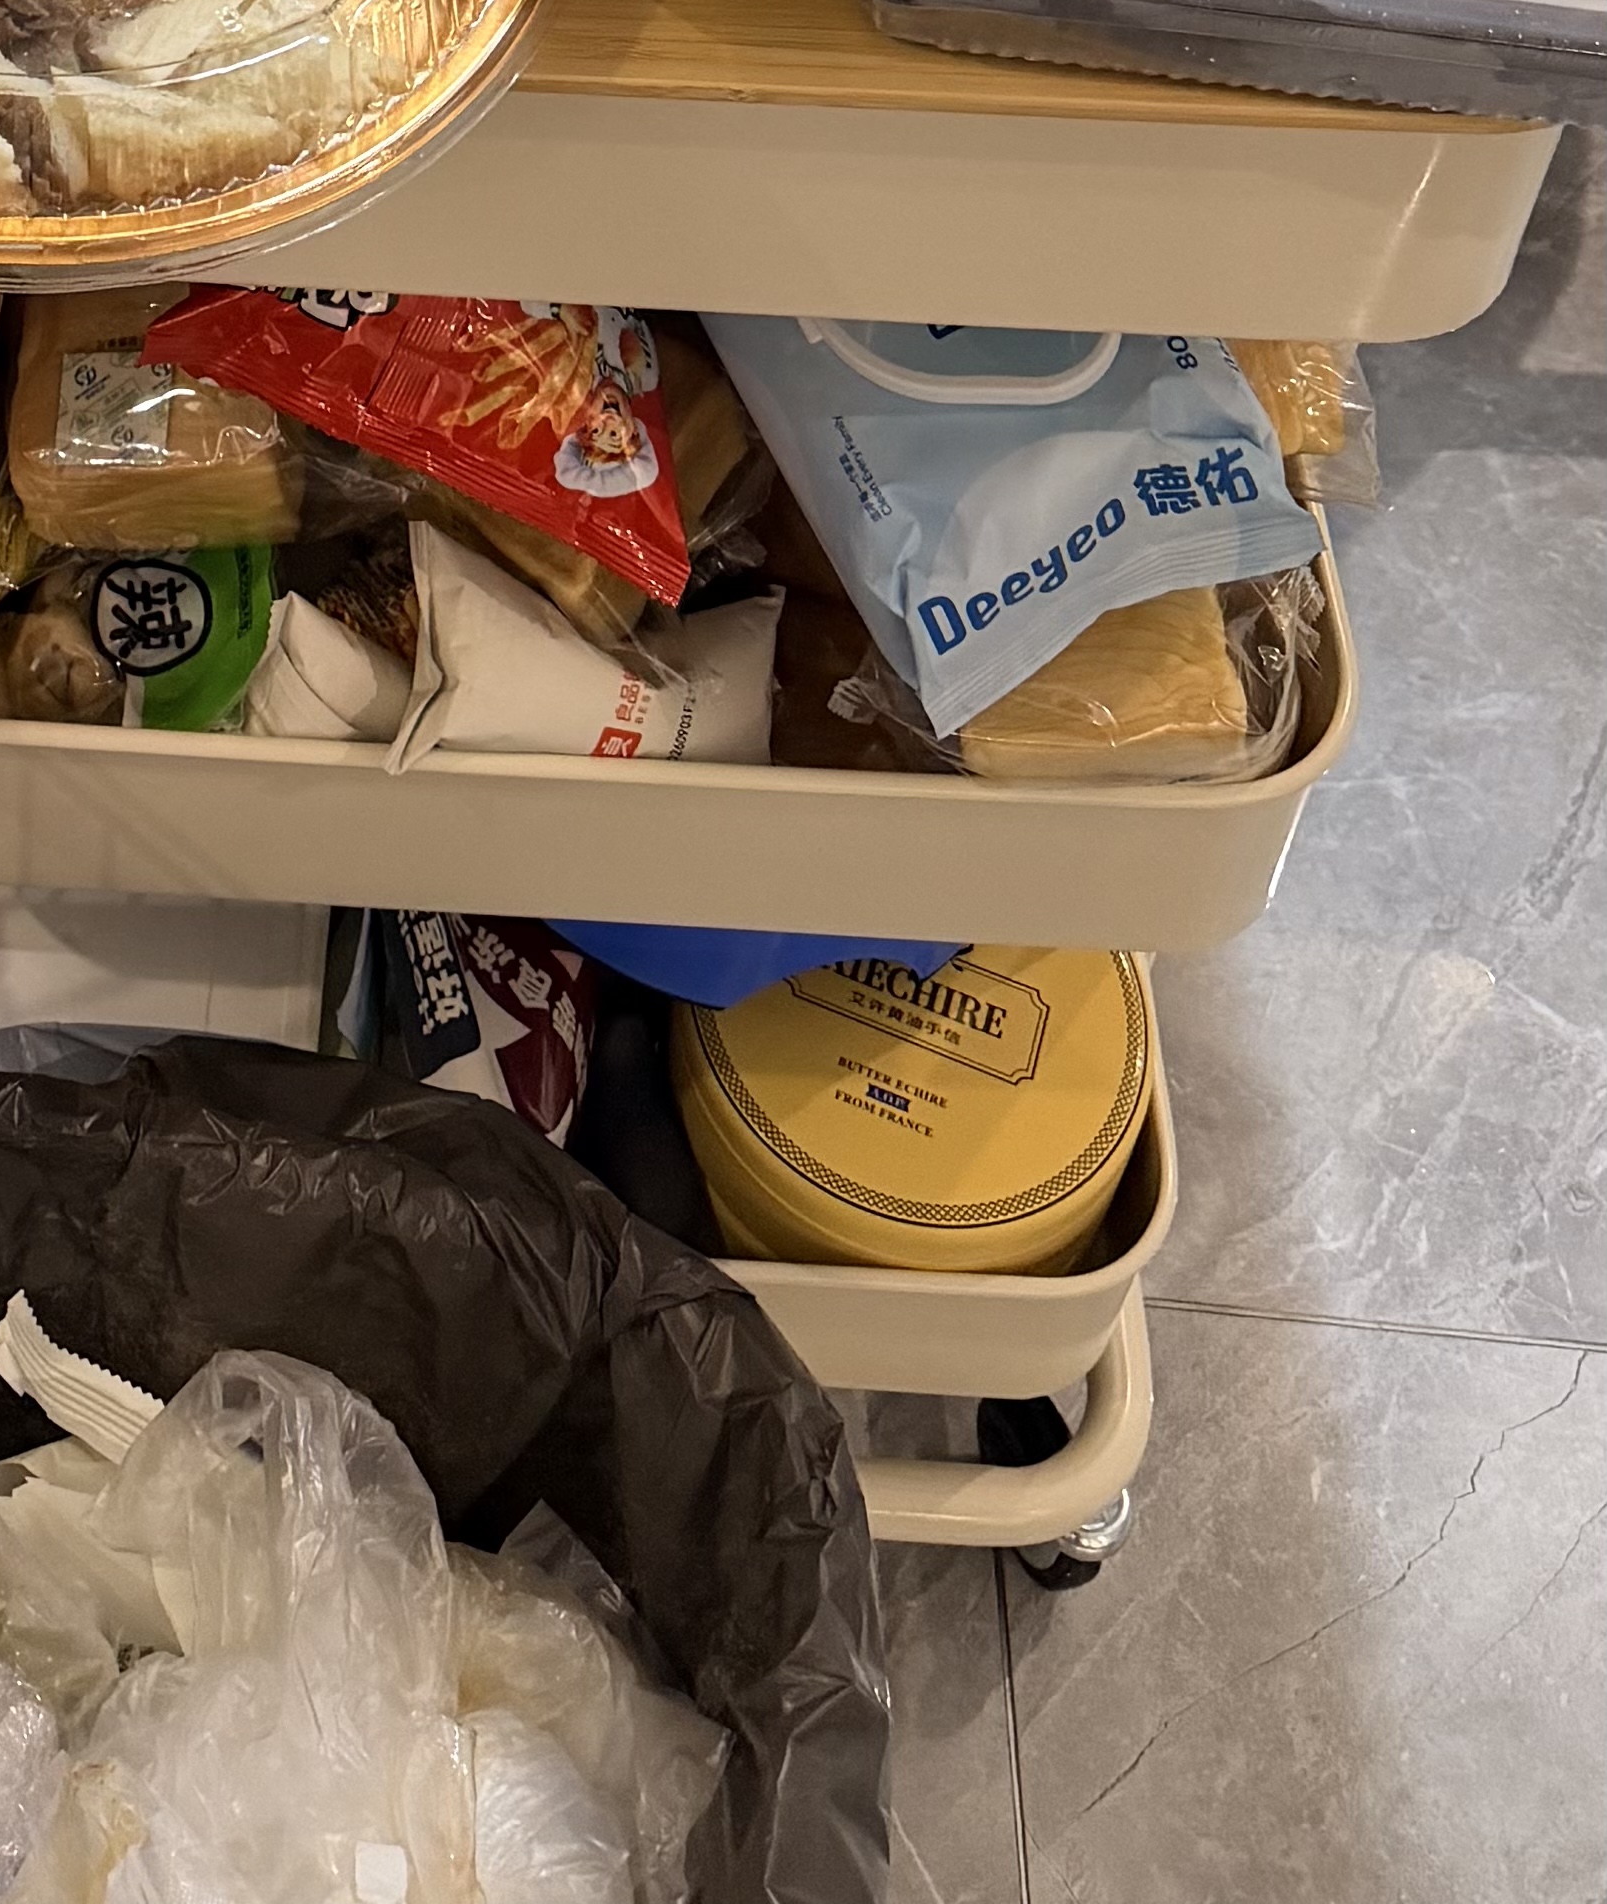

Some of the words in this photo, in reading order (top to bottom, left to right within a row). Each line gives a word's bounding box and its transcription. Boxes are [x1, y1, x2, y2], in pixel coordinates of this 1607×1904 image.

[830, 413, 856, 452] Family
[850, 449, 874, 483] Every
[868, 480, 893, 516] Clean
[917, 498, 1127, 656] Deeyeo
[1133, 446, 1259, 518] 德佑
[411, 911, 469, 1025] 好适
[838, 1056, 892, 1085] BUTTER
[896, 1078, 949, 1108] ECHIRE
[835, 1090, 876, 1114] FROM
[878, 1106, 934, 1137] FRANCE
